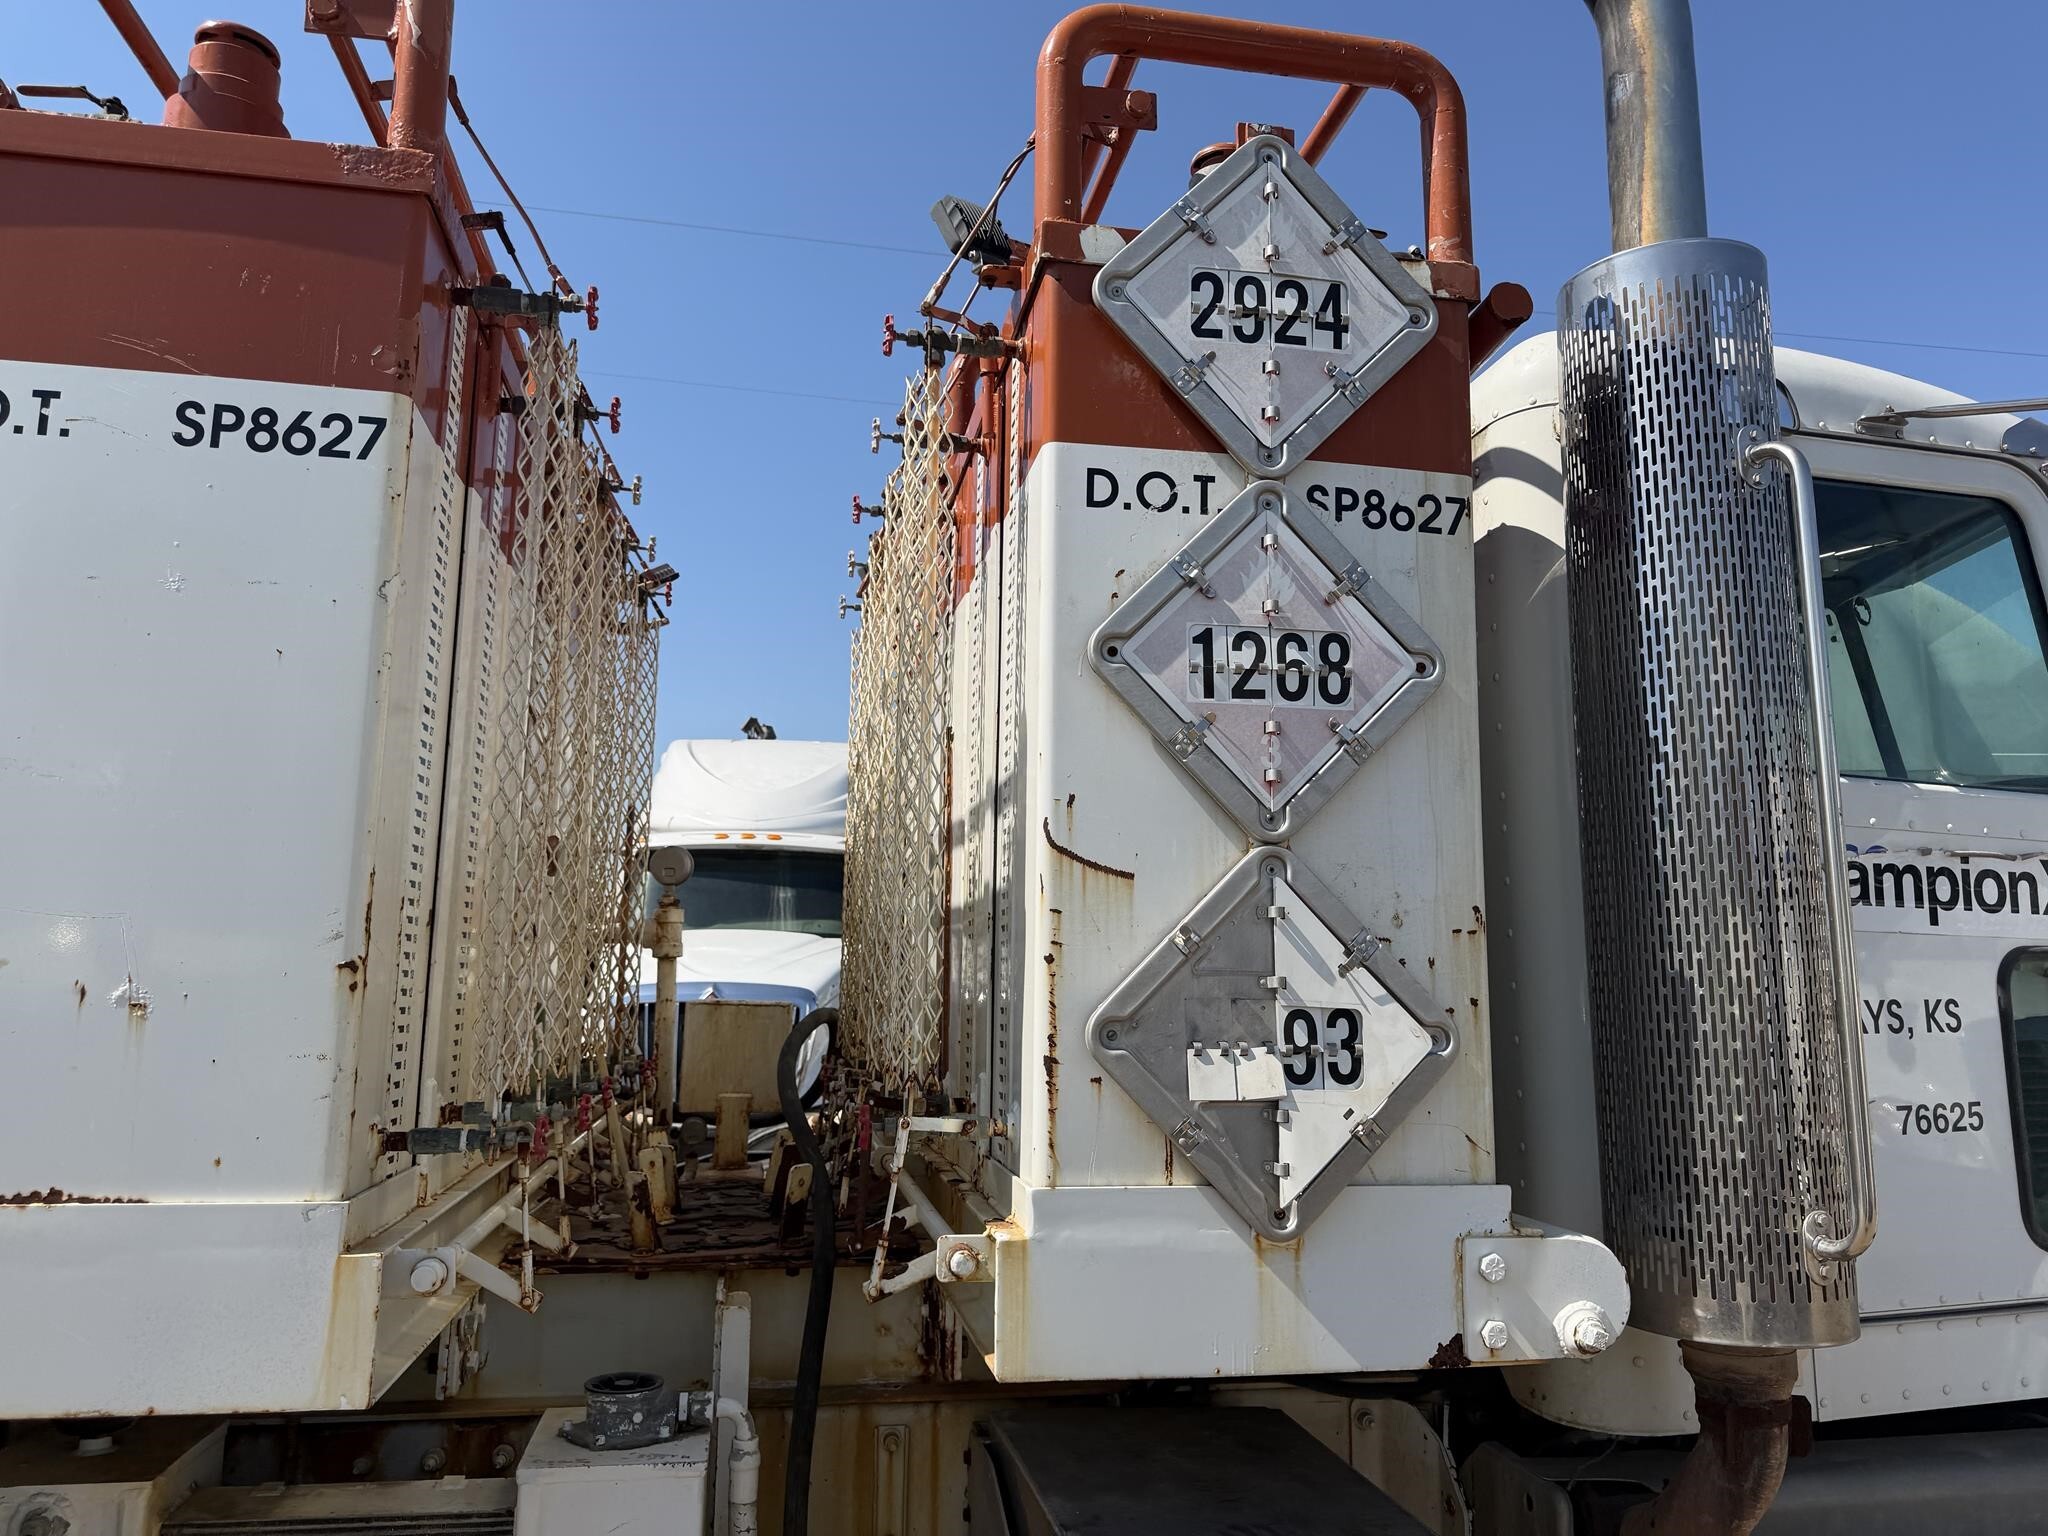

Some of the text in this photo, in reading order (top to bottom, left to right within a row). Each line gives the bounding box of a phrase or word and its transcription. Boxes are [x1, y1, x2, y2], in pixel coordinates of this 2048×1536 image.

[1191, 271, 1349, 350] 2924
[0, 389, 388, 461] .T. SP8627
[1086, 467, 1467, 536] D.O.T SP8627
[1192, 627, 1351, 705] 1268
[1260, 734, 1282, 769] 3
[1283, 1007, 1362, 1086] 93
[1861, 998, 1962, 1040] YS, KS
[1896, 1101, 1984, 1136] 76625
